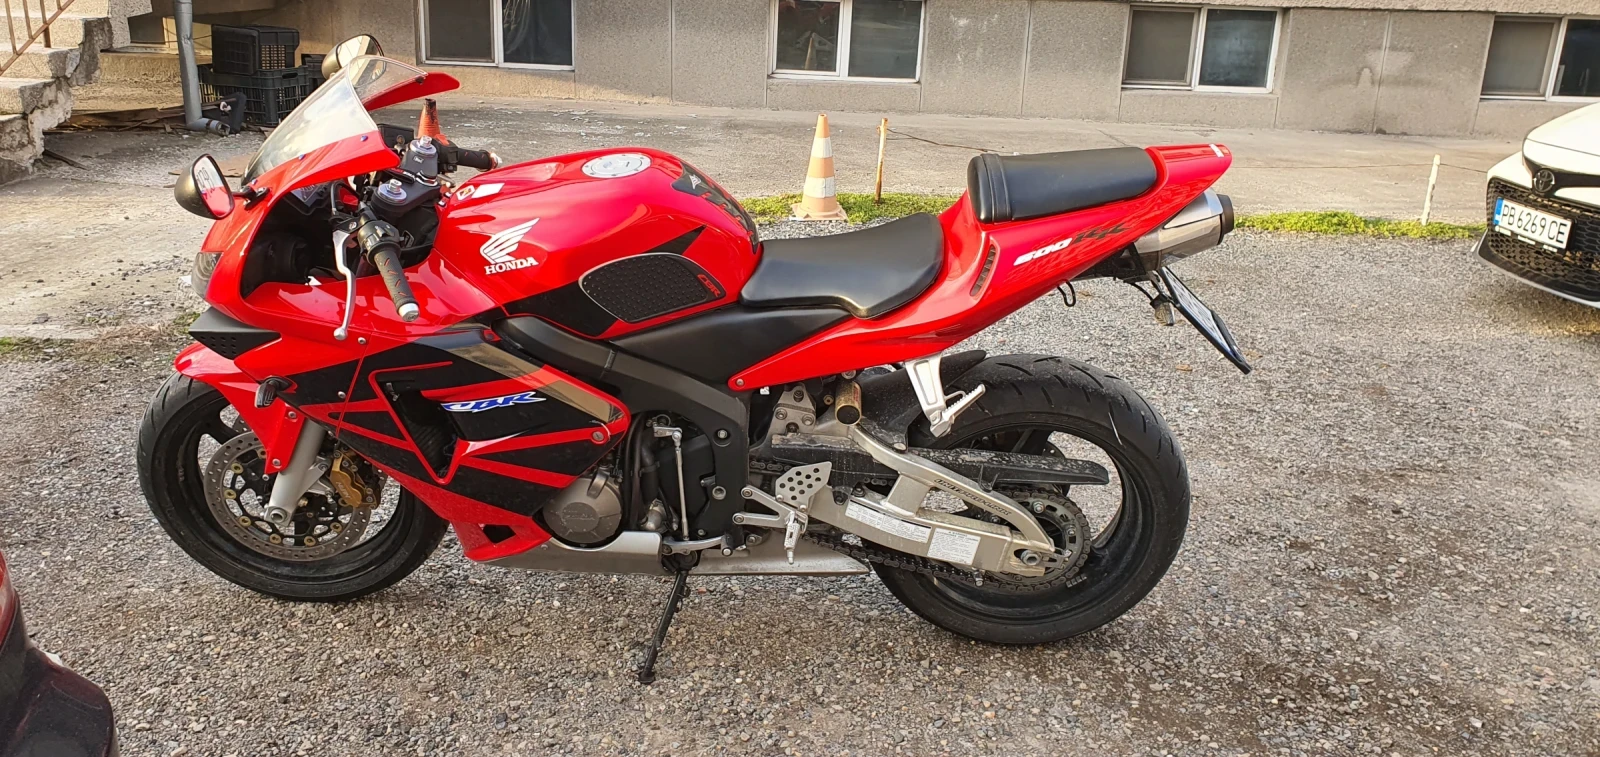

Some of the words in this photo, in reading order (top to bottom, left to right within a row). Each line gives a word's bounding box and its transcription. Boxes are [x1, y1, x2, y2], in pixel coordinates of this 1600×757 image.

[1501, 204, 1516, 226] PB
[1516, 210, 1547, 236] 6269
[1548, 220, 1568, 244] CE
[484, 256, 540, 275] HONDA
[697, 273, 721, 298] CBR
